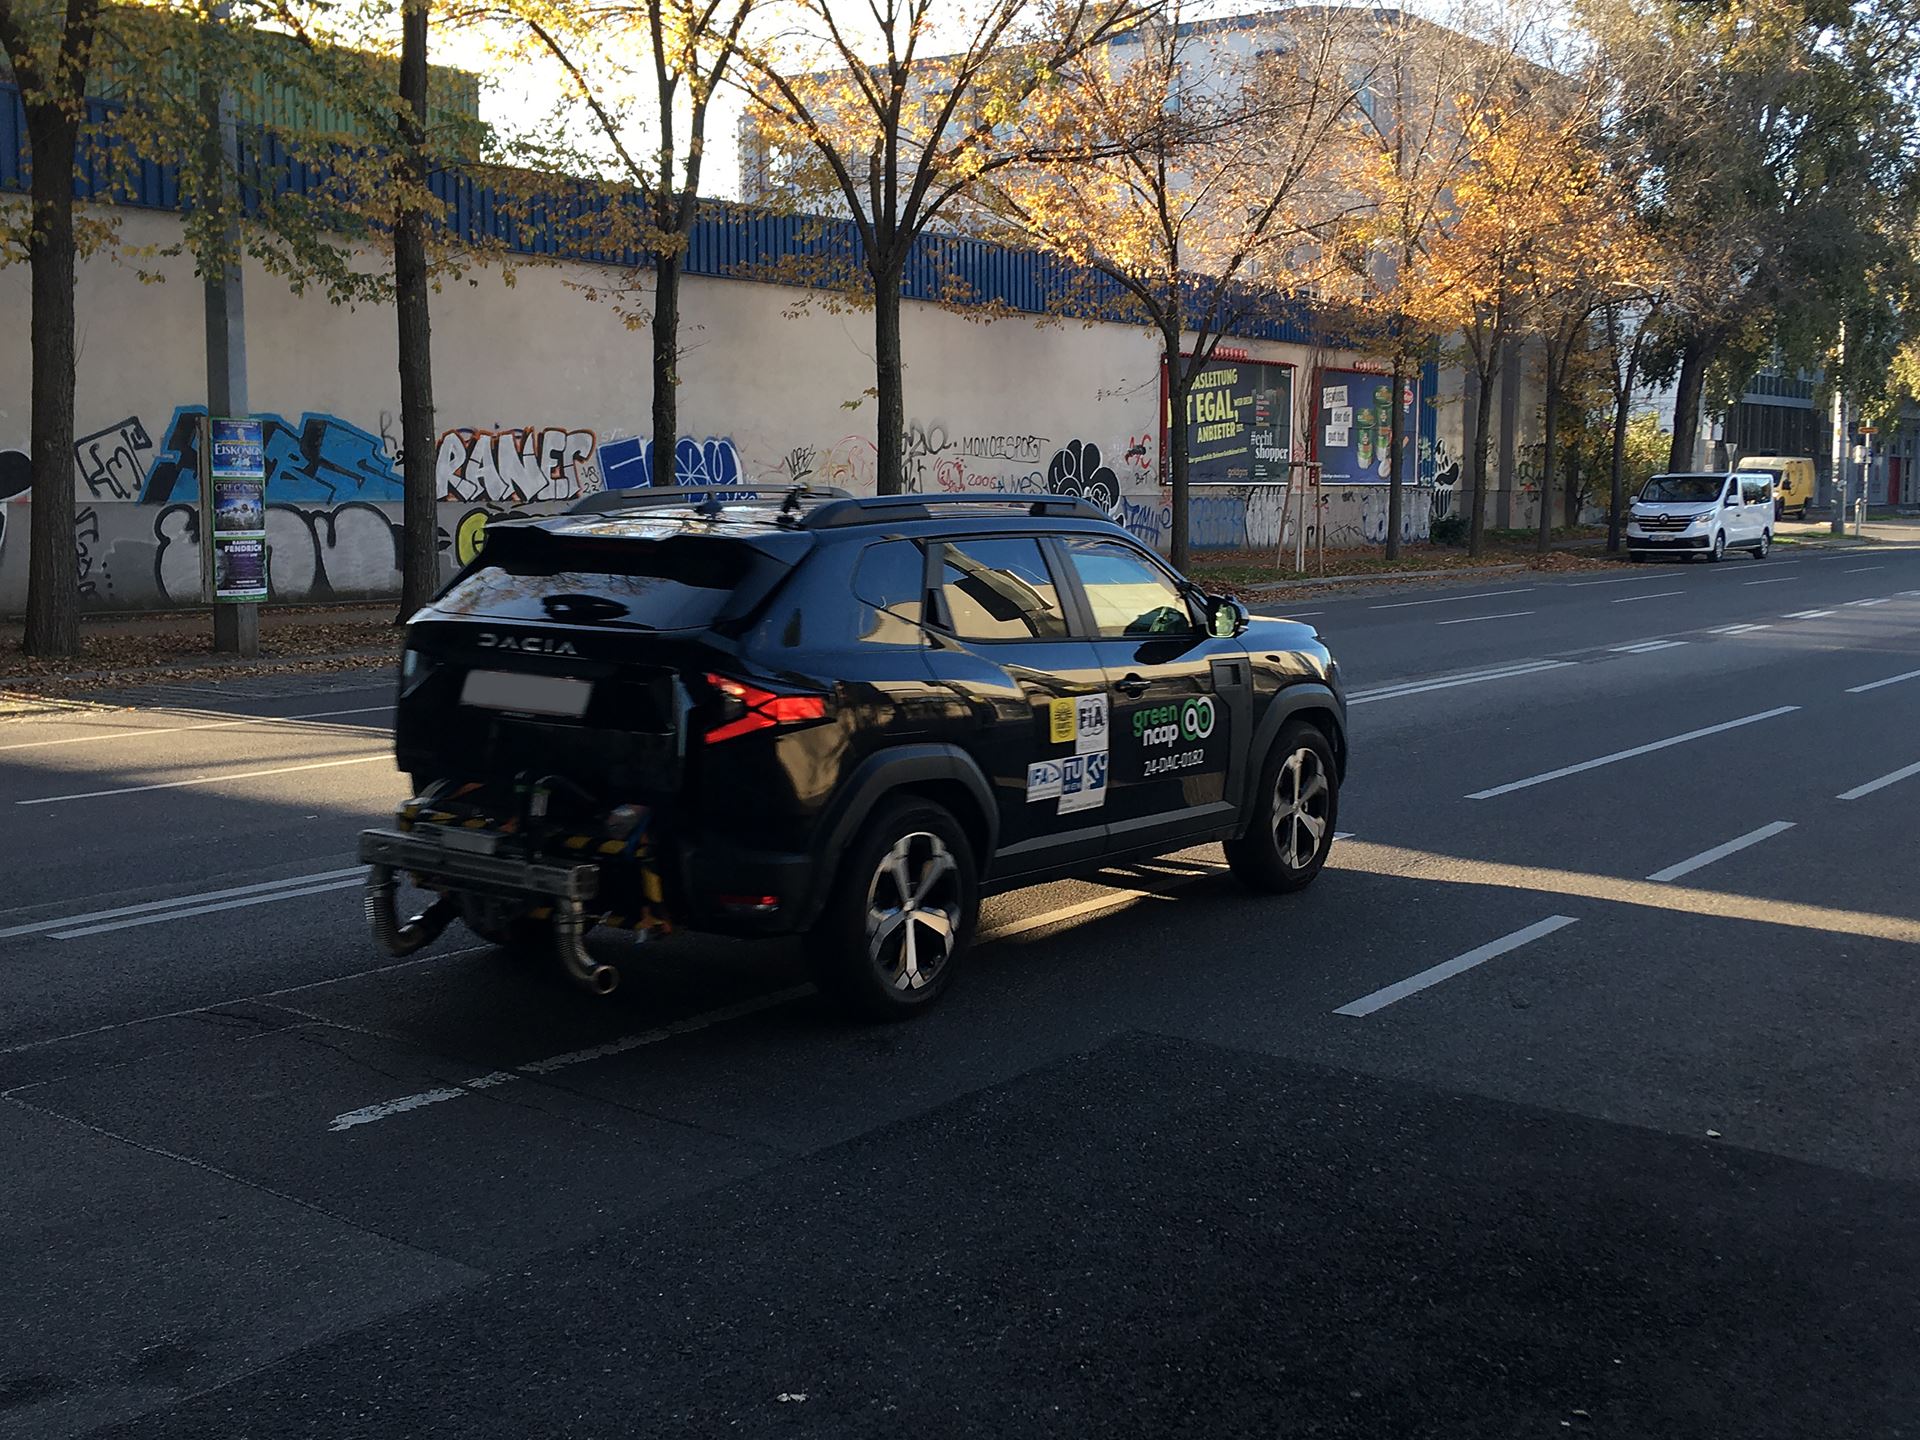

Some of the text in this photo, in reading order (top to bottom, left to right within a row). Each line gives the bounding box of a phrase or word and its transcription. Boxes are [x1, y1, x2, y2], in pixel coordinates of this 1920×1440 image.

[1196, 389, 1239, 424] EGAL,
[1197, 422, 1236, 443] ANBIETER
[1254, 444, 1289, 462] shopper
[224, 544, 262, 553] FENDRICH
[478, 632, 578, 655] DACIA
[1132, 704, 1179, 737] green
[1142, 723, 1180, 748] ncap
